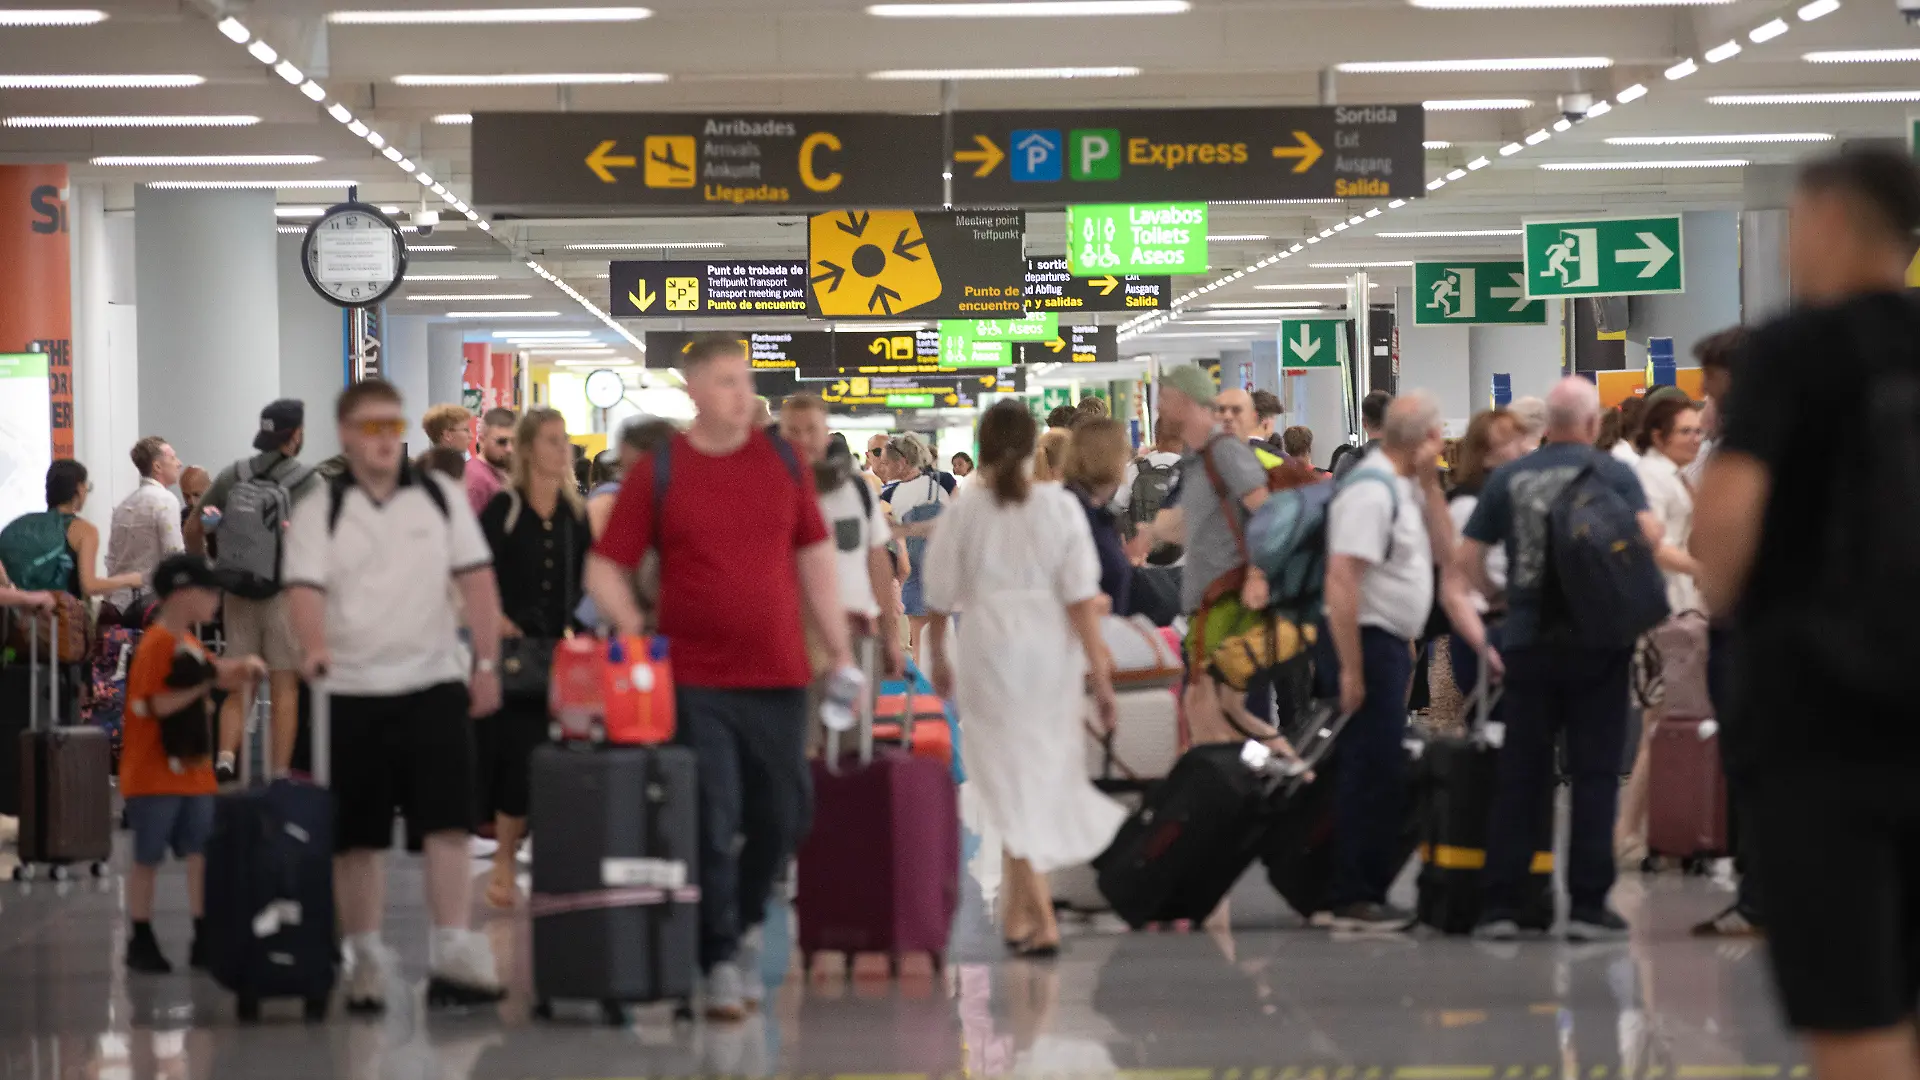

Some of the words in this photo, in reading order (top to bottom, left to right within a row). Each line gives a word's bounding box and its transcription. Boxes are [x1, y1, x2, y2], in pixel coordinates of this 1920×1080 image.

[1335, 106, 1398, 124] Sortida
[704, 118, 797, 136] Arribades
[1335, 131, 1359, 148] Exit
[704, 140, 761, 157] Arrivals
[1081, 135, 1109, 174] P
[1127, 138, 1248, 169] Express
[799, 131, 843, 193] C
[1335, 154, 1392, 175] Ausgang
[704, 161, 761, 179] Ankunft
[1335, 178, 1390, 196] Salida
[704, 184, 790, 204] Llegadas
[956, 216, 993, 227] Meeting
[996, 216, 1019, 227] point
[1129, 206, 1203, 225] Lavabos
[973, 230, 1019, 241] Treffpunkt
[1130, 226, 1190, 245] Toilets
[1130, 246, 1185, 265] Aseos
[707, 265, 731, 275] Punt
[733, 265, 746, 275] de
[748, 265, 788, 275] trobada
[790, 265, 804, 275] de
[708, 277, 748, 288] Treffpunkt
[749, 277, 787, 288] Transport
[1024, 272, 1070, 283] departures
[708, 288, 747, 299] Transport
[749, 288, 782, 299] meeting
[783, 288, 804, 298] point
[964, 286, 1000, 296] Punto
[1005, 286, 1020, 296] de
[1035, 284, 1063, 295] Abflug
[1125, 283, 1160, 295] Ausgang
[707, 300, 737, 310] Punto
[740, 300, 752, 310] de
[755, 300, 806, 310] encuentro
[959, 301, 1020, 311] encuentro
[1035, 300, 1042, 309] y
[1044, 297, 1084, 307] salidas
[1125, 296, 1159, 307] Salida
[1008, 322, 1044, 334] Aseos
